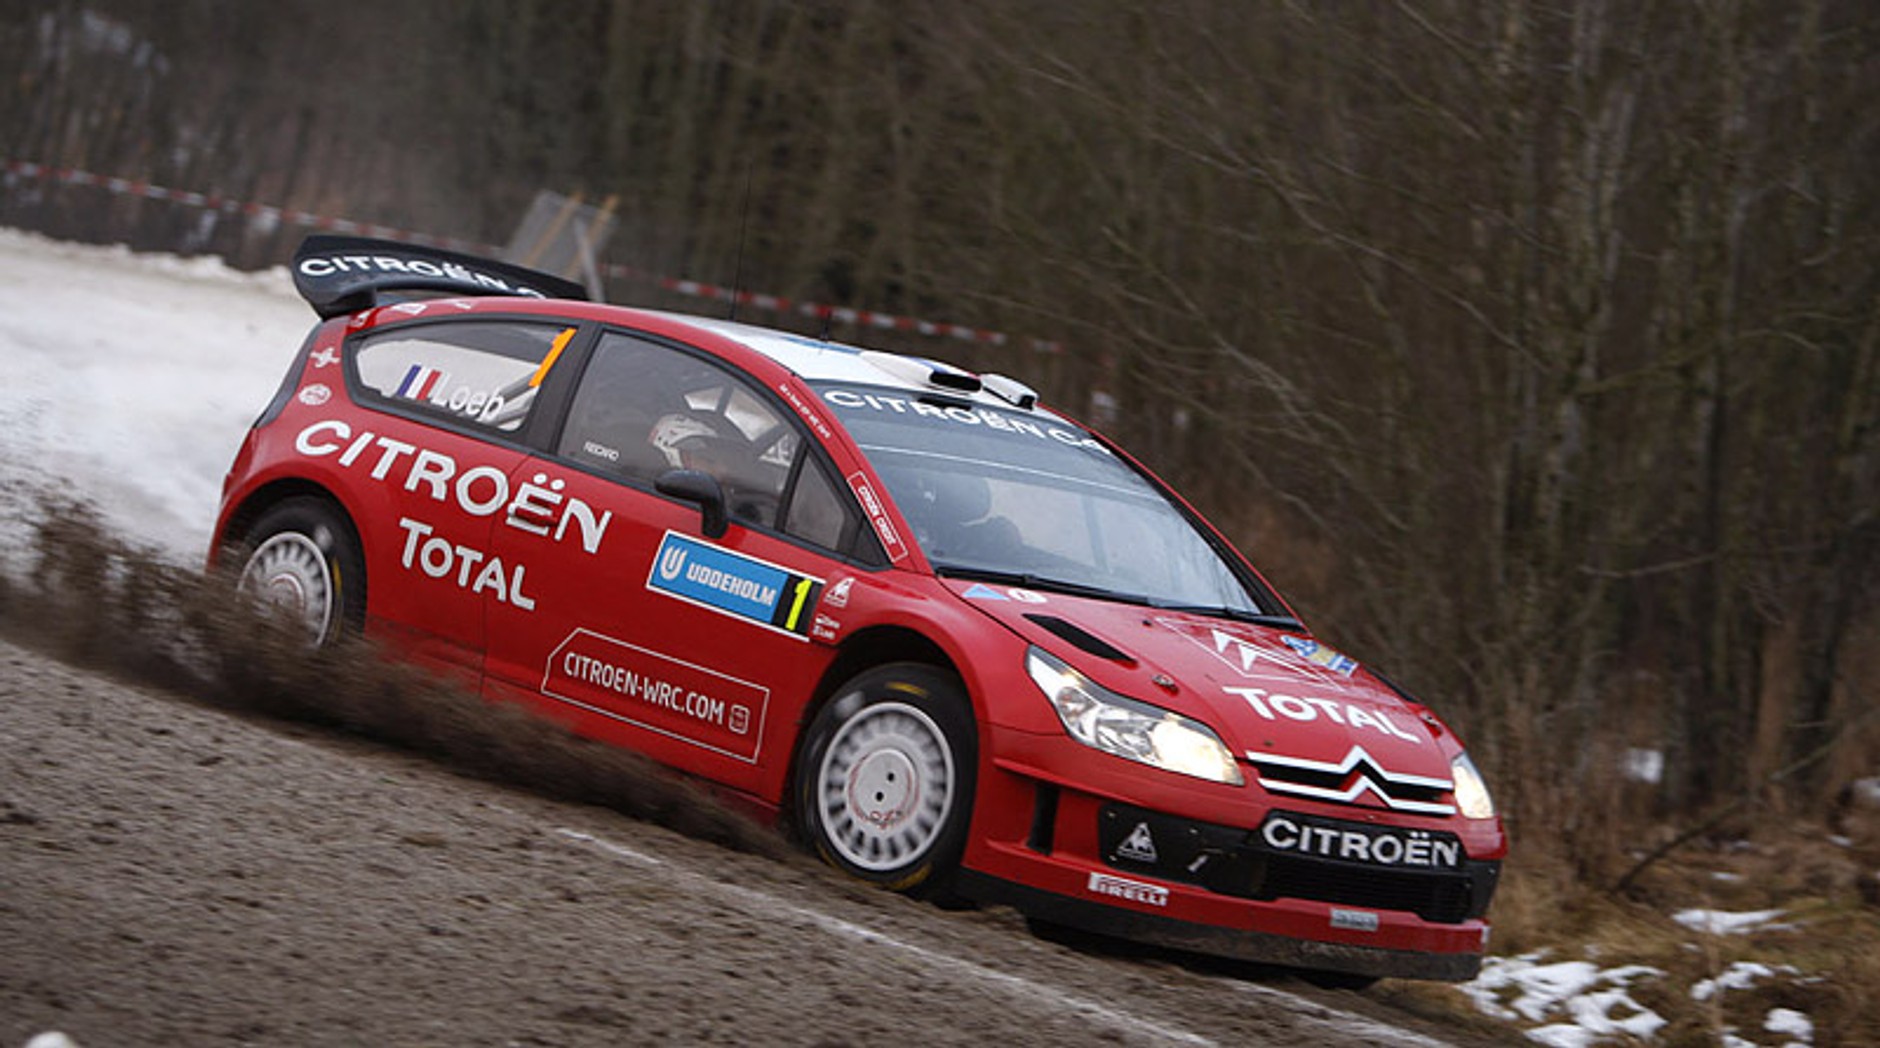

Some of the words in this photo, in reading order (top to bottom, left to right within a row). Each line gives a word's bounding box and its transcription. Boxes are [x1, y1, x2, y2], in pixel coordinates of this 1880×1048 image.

[528, 328, 577, 388] 1
[431, 382, 505, 423] Loeb
[824, 390, 1046, 439] CITROËN
[295, 420, 612, 554] CITROËN
[399, 517, 536, 611] TOTAL
[686, 562, 777, 607] UDDEHOLM
[785, 578, 812, 631] 1
[563, 651, 726, 727] CITROEN-WRC.COM
[1222, 685, 1422, 744] TOTAL
[1262, 816, 1460, 868] CITROËN
